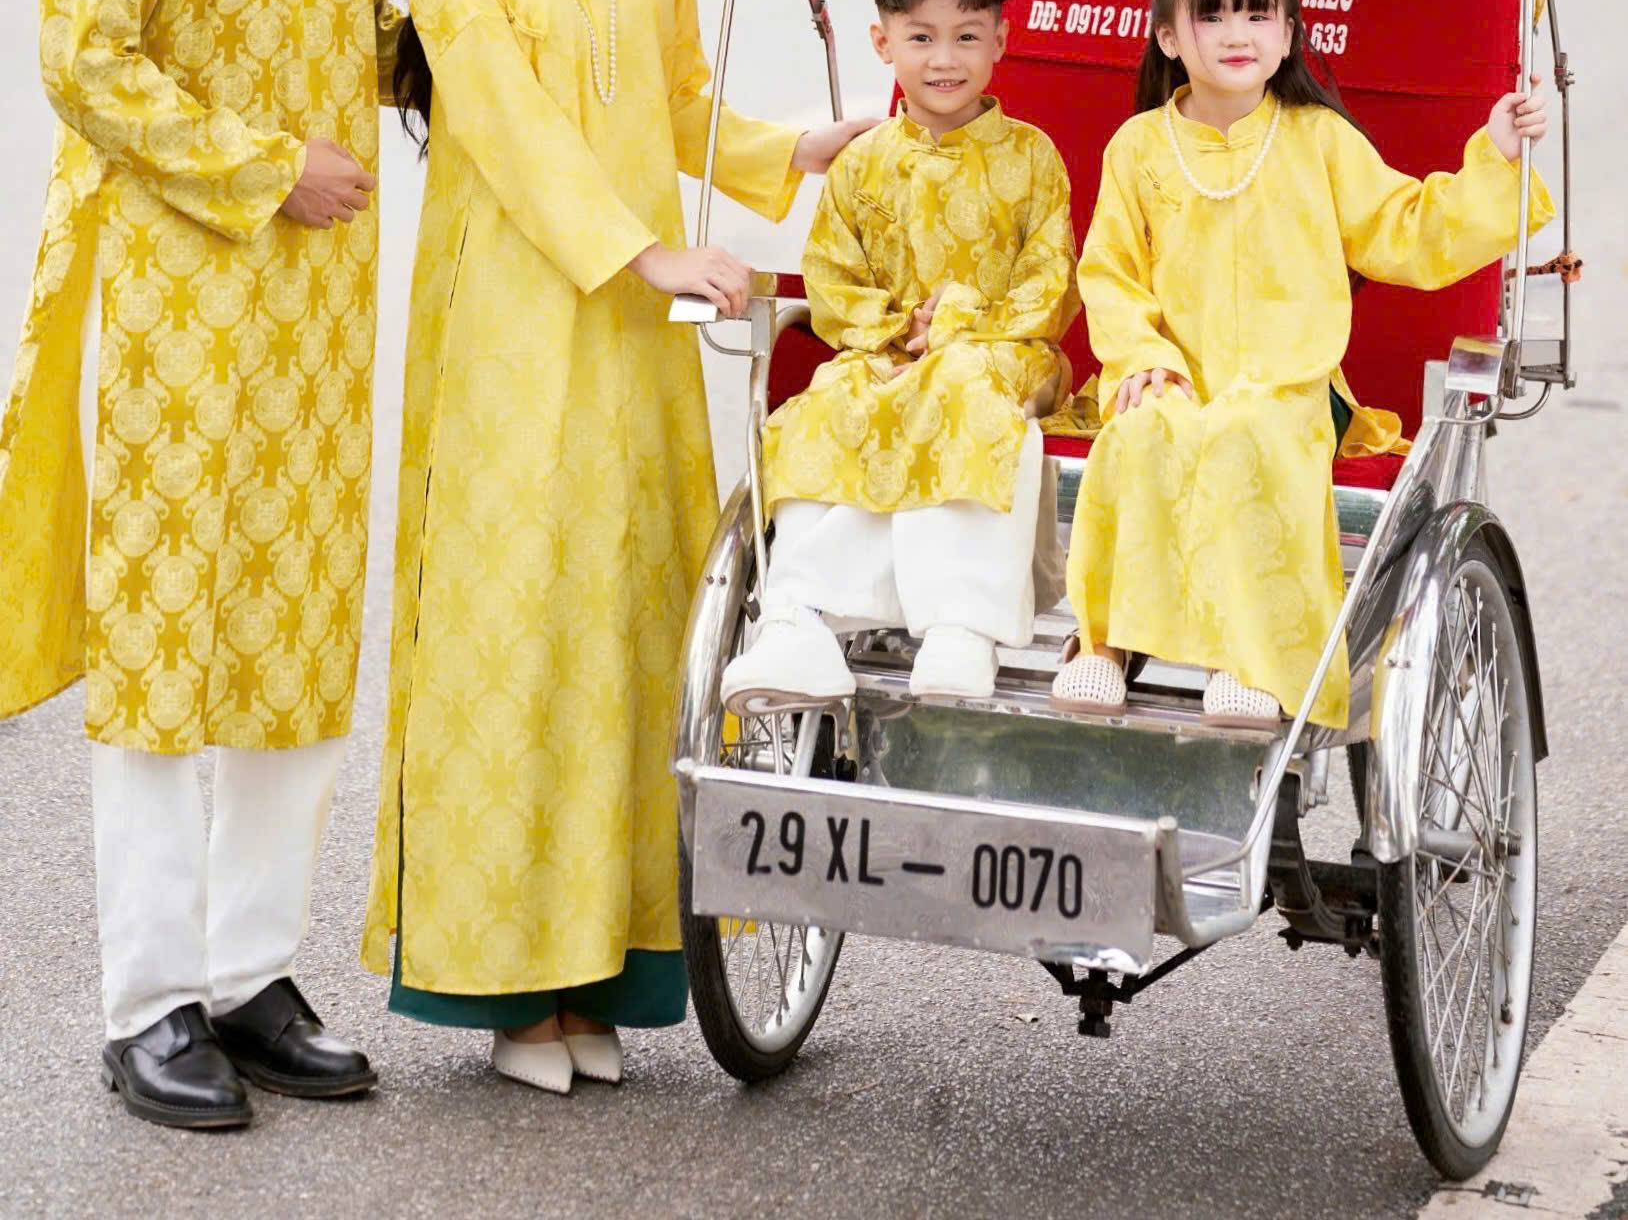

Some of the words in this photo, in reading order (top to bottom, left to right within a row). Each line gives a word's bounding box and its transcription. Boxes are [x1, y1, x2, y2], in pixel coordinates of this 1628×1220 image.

[1064, 3, 1116, 36] 0912
[1310, 22, 1349, 55] 633
[740, 810, 806, 877] 29
[826, 816, 885, 886] XL
[971, 843, 1084, 919] 0070
